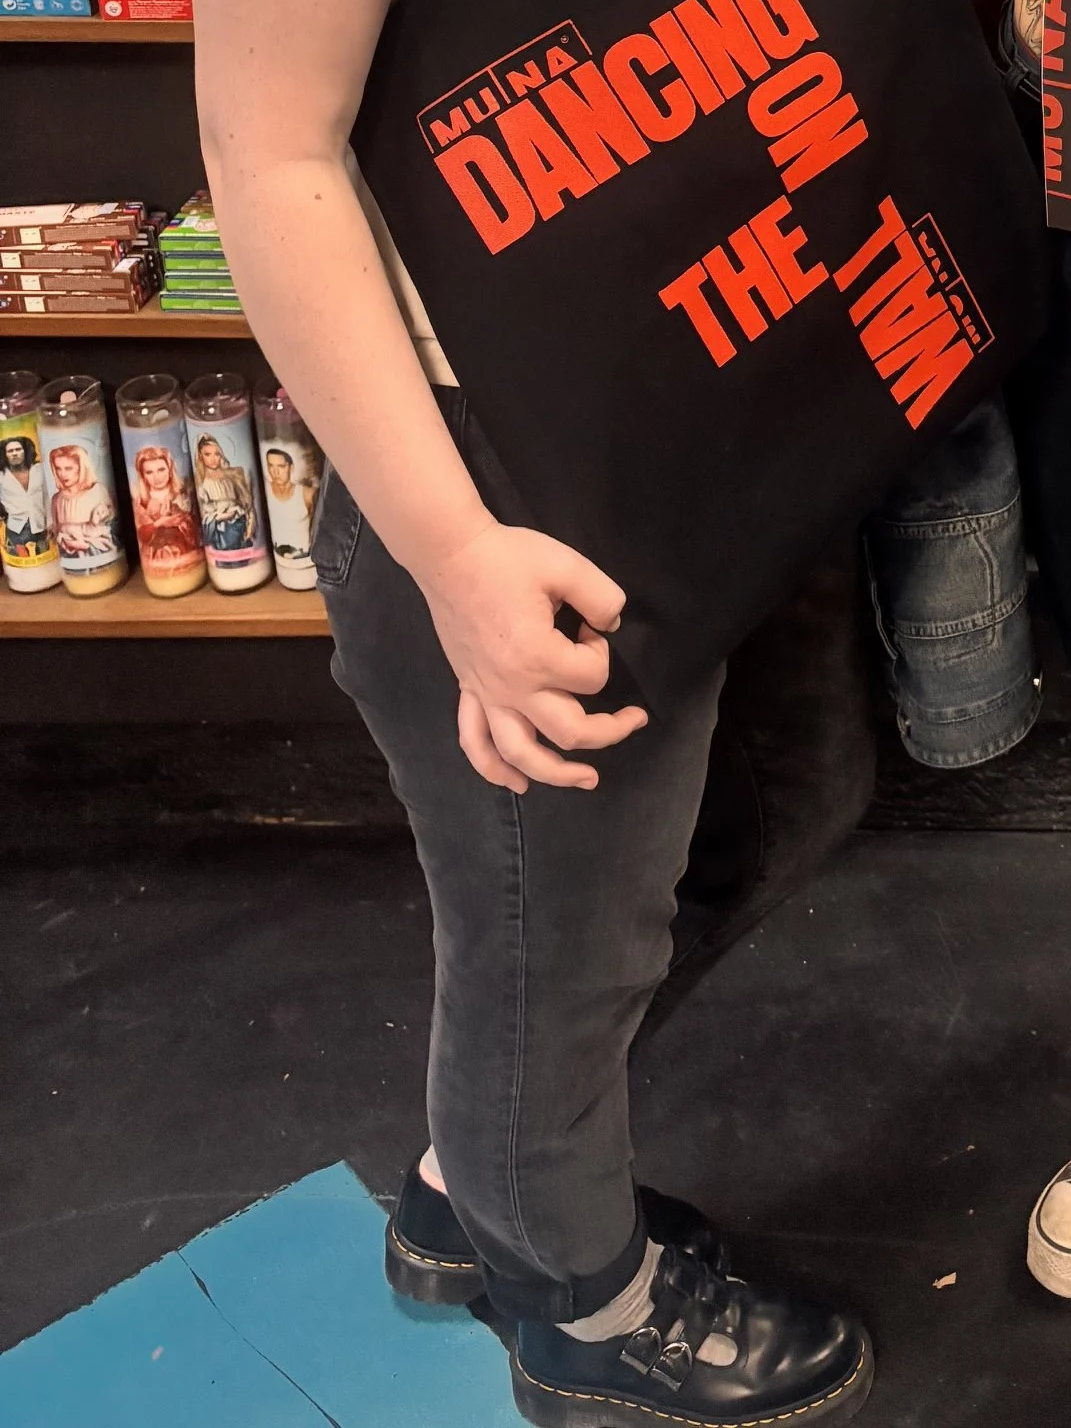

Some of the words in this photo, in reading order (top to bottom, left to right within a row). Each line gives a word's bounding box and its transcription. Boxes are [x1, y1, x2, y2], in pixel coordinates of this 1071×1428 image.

[430, 45, 580, 147] MUNA
[747, 52, 869, 194] ON
[658, 195, 830, 368] THE
[833, 195, 975, 431] WALL
